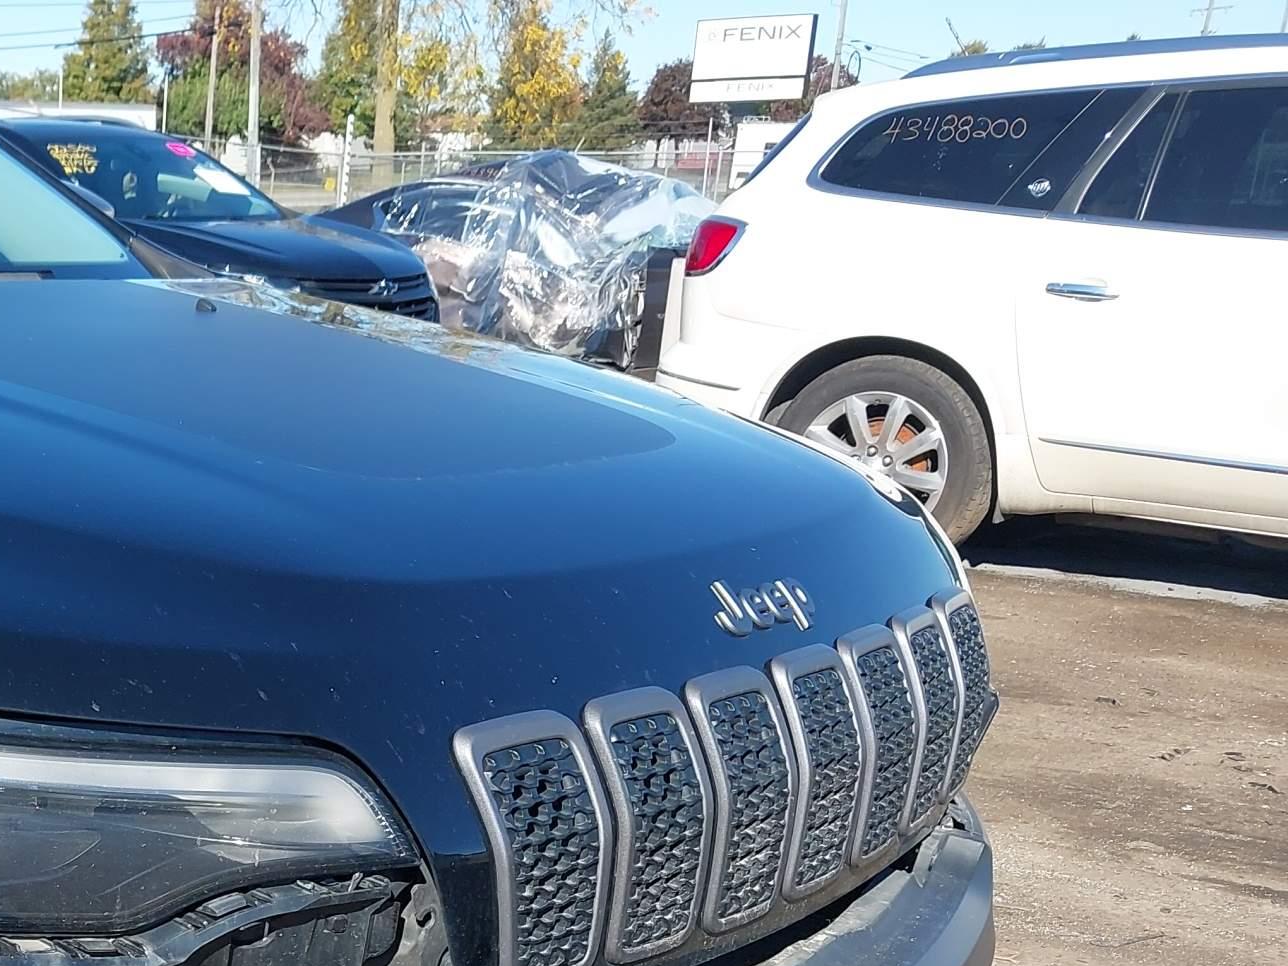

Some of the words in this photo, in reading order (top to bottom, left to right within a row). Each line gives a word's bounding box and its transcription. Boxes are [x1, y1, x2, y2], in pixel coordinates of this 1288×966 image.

[723, 24, 802, 42] FENIX
[882, 114, 1027, 145] 43488200
[710, 577, 815, 637] Jeep
